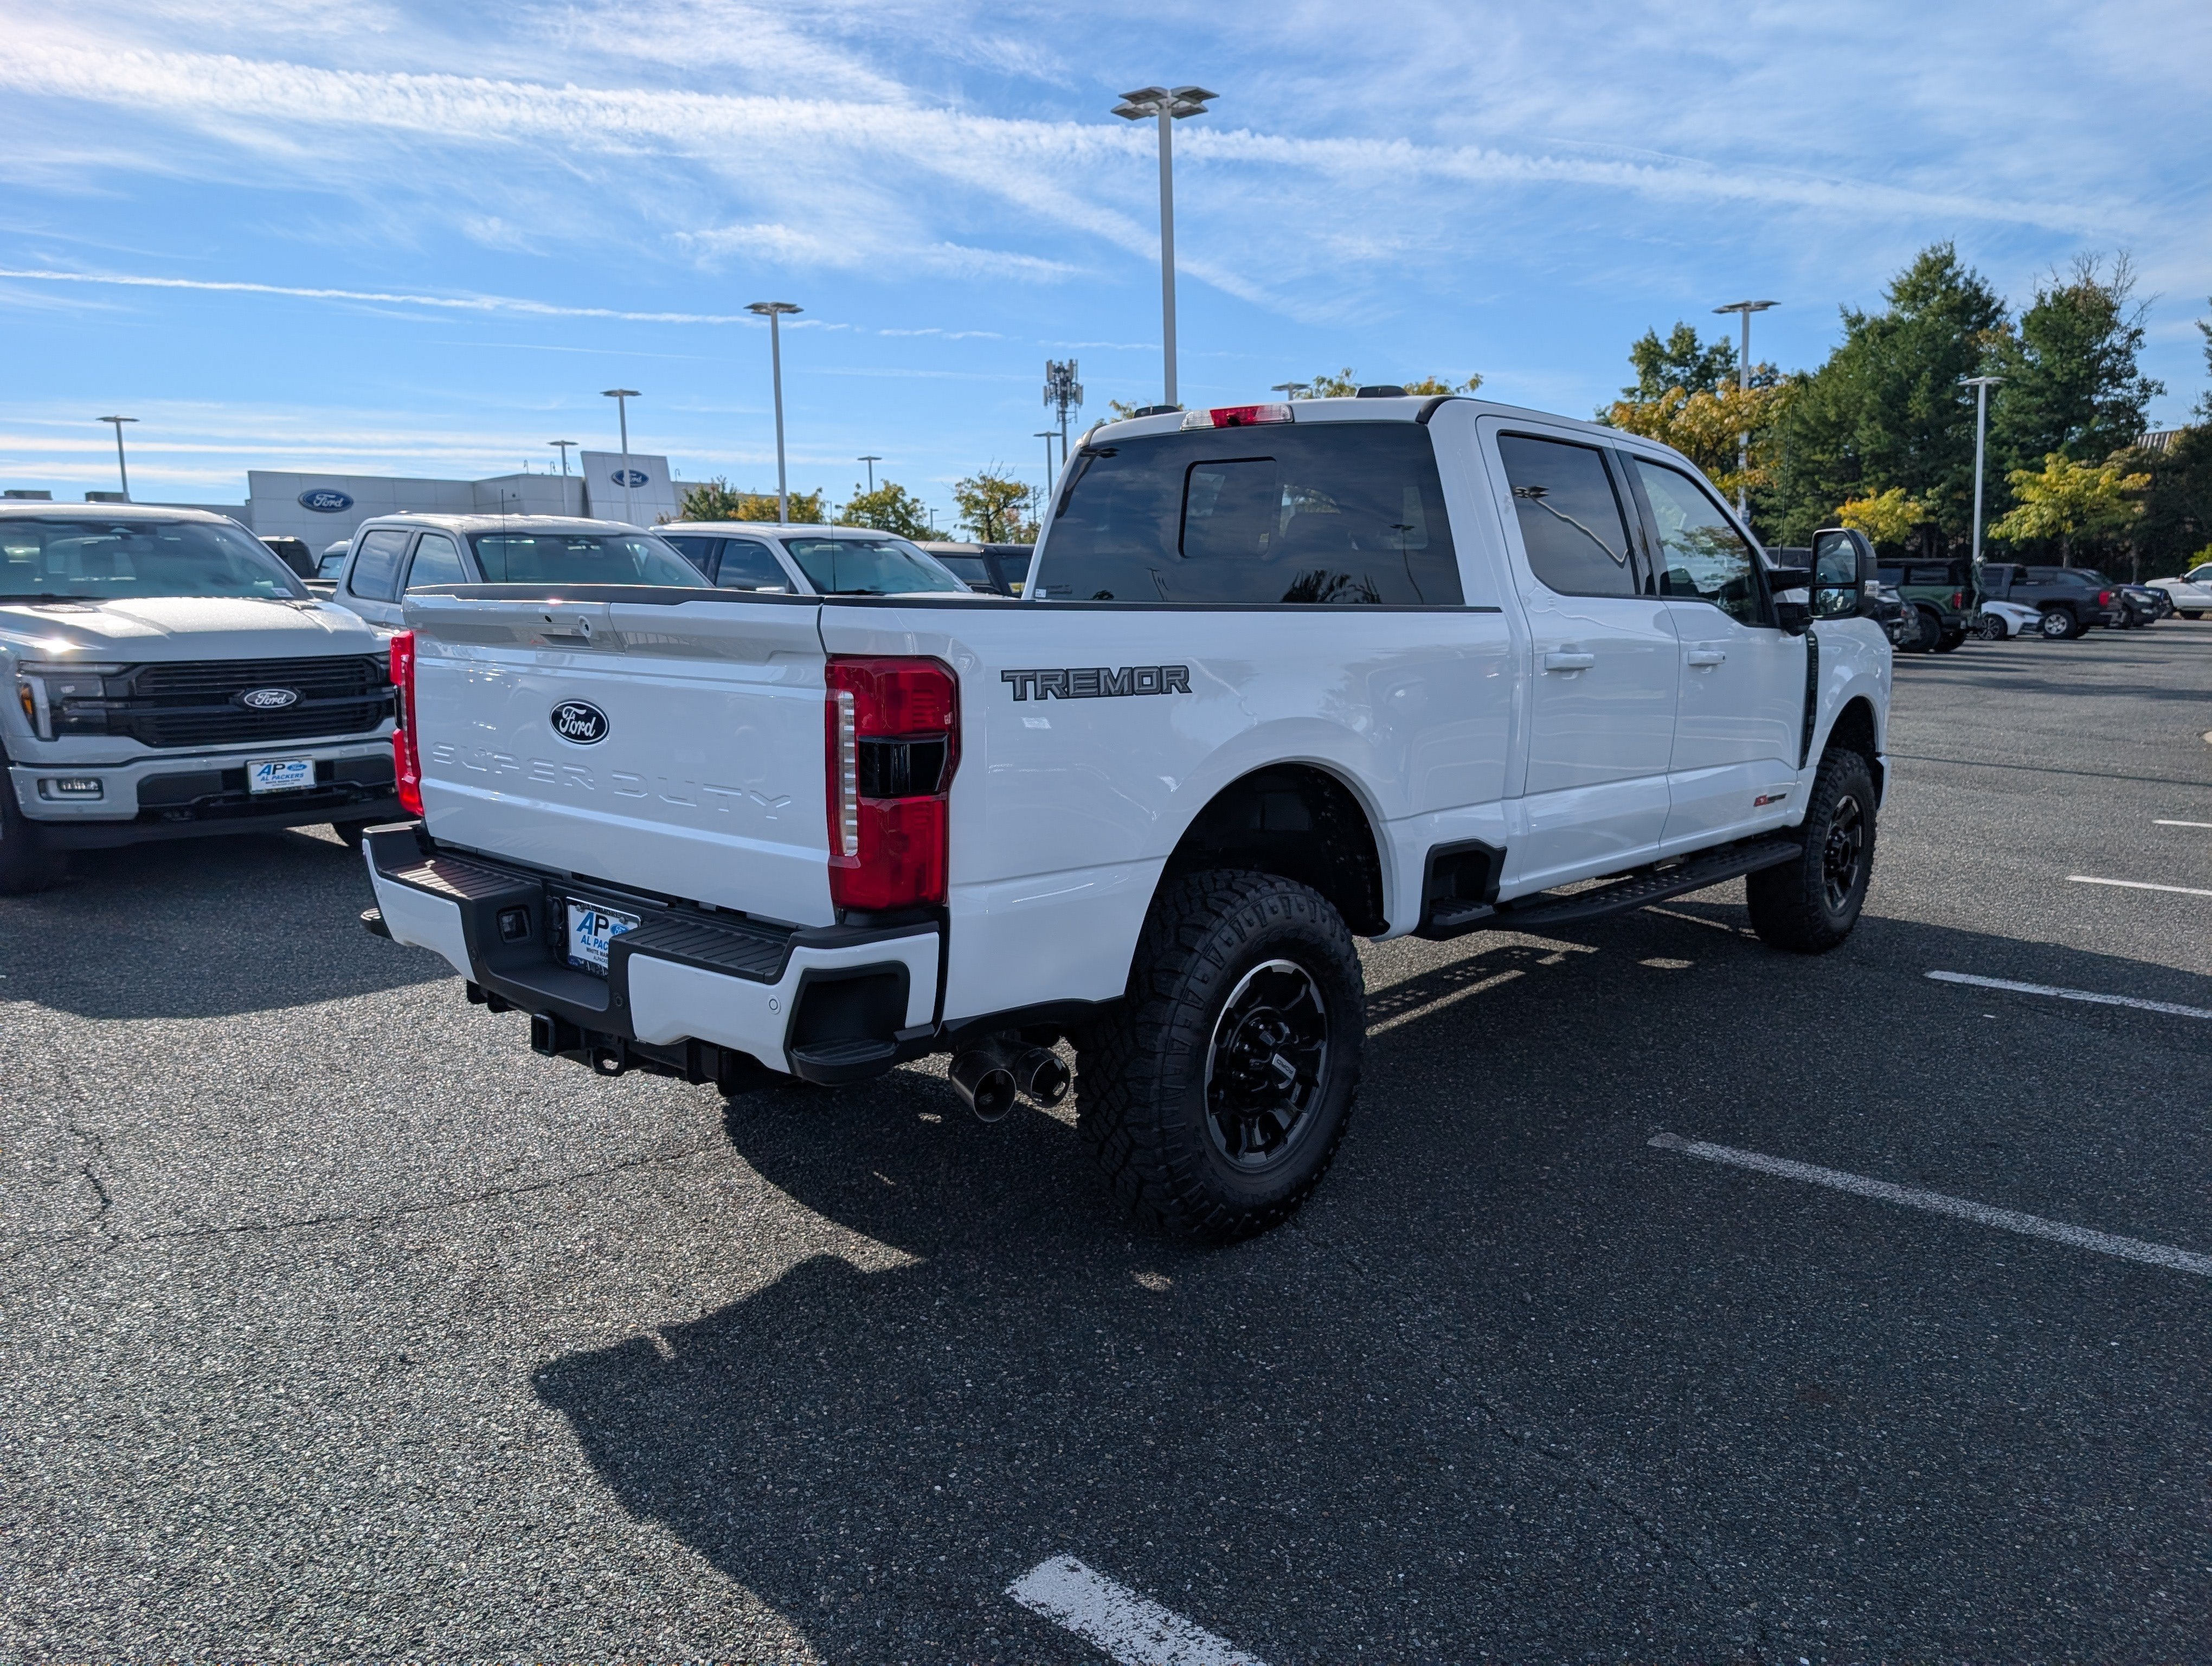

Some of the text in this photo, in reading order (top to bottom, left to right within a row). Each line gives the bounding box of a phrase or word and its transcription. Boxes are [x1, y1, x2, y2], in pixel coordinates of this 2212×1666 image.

[313, 493, 344, 507] Ford
[1000, 665, 1193, 702] TREMOR
[255, 691, 286, 705] Ford
[559, 706, 596, 737] Ford
[256, 764, 286, 776] AP
[433, 741, 791, 819] SUPER DUTY
[583, 904, 621, 918] BALTIMORE
[576, 911, 609, 937] AP
[581, 934, 608, 951] AL PAC
[586, 946, 600, 956] WHITE
